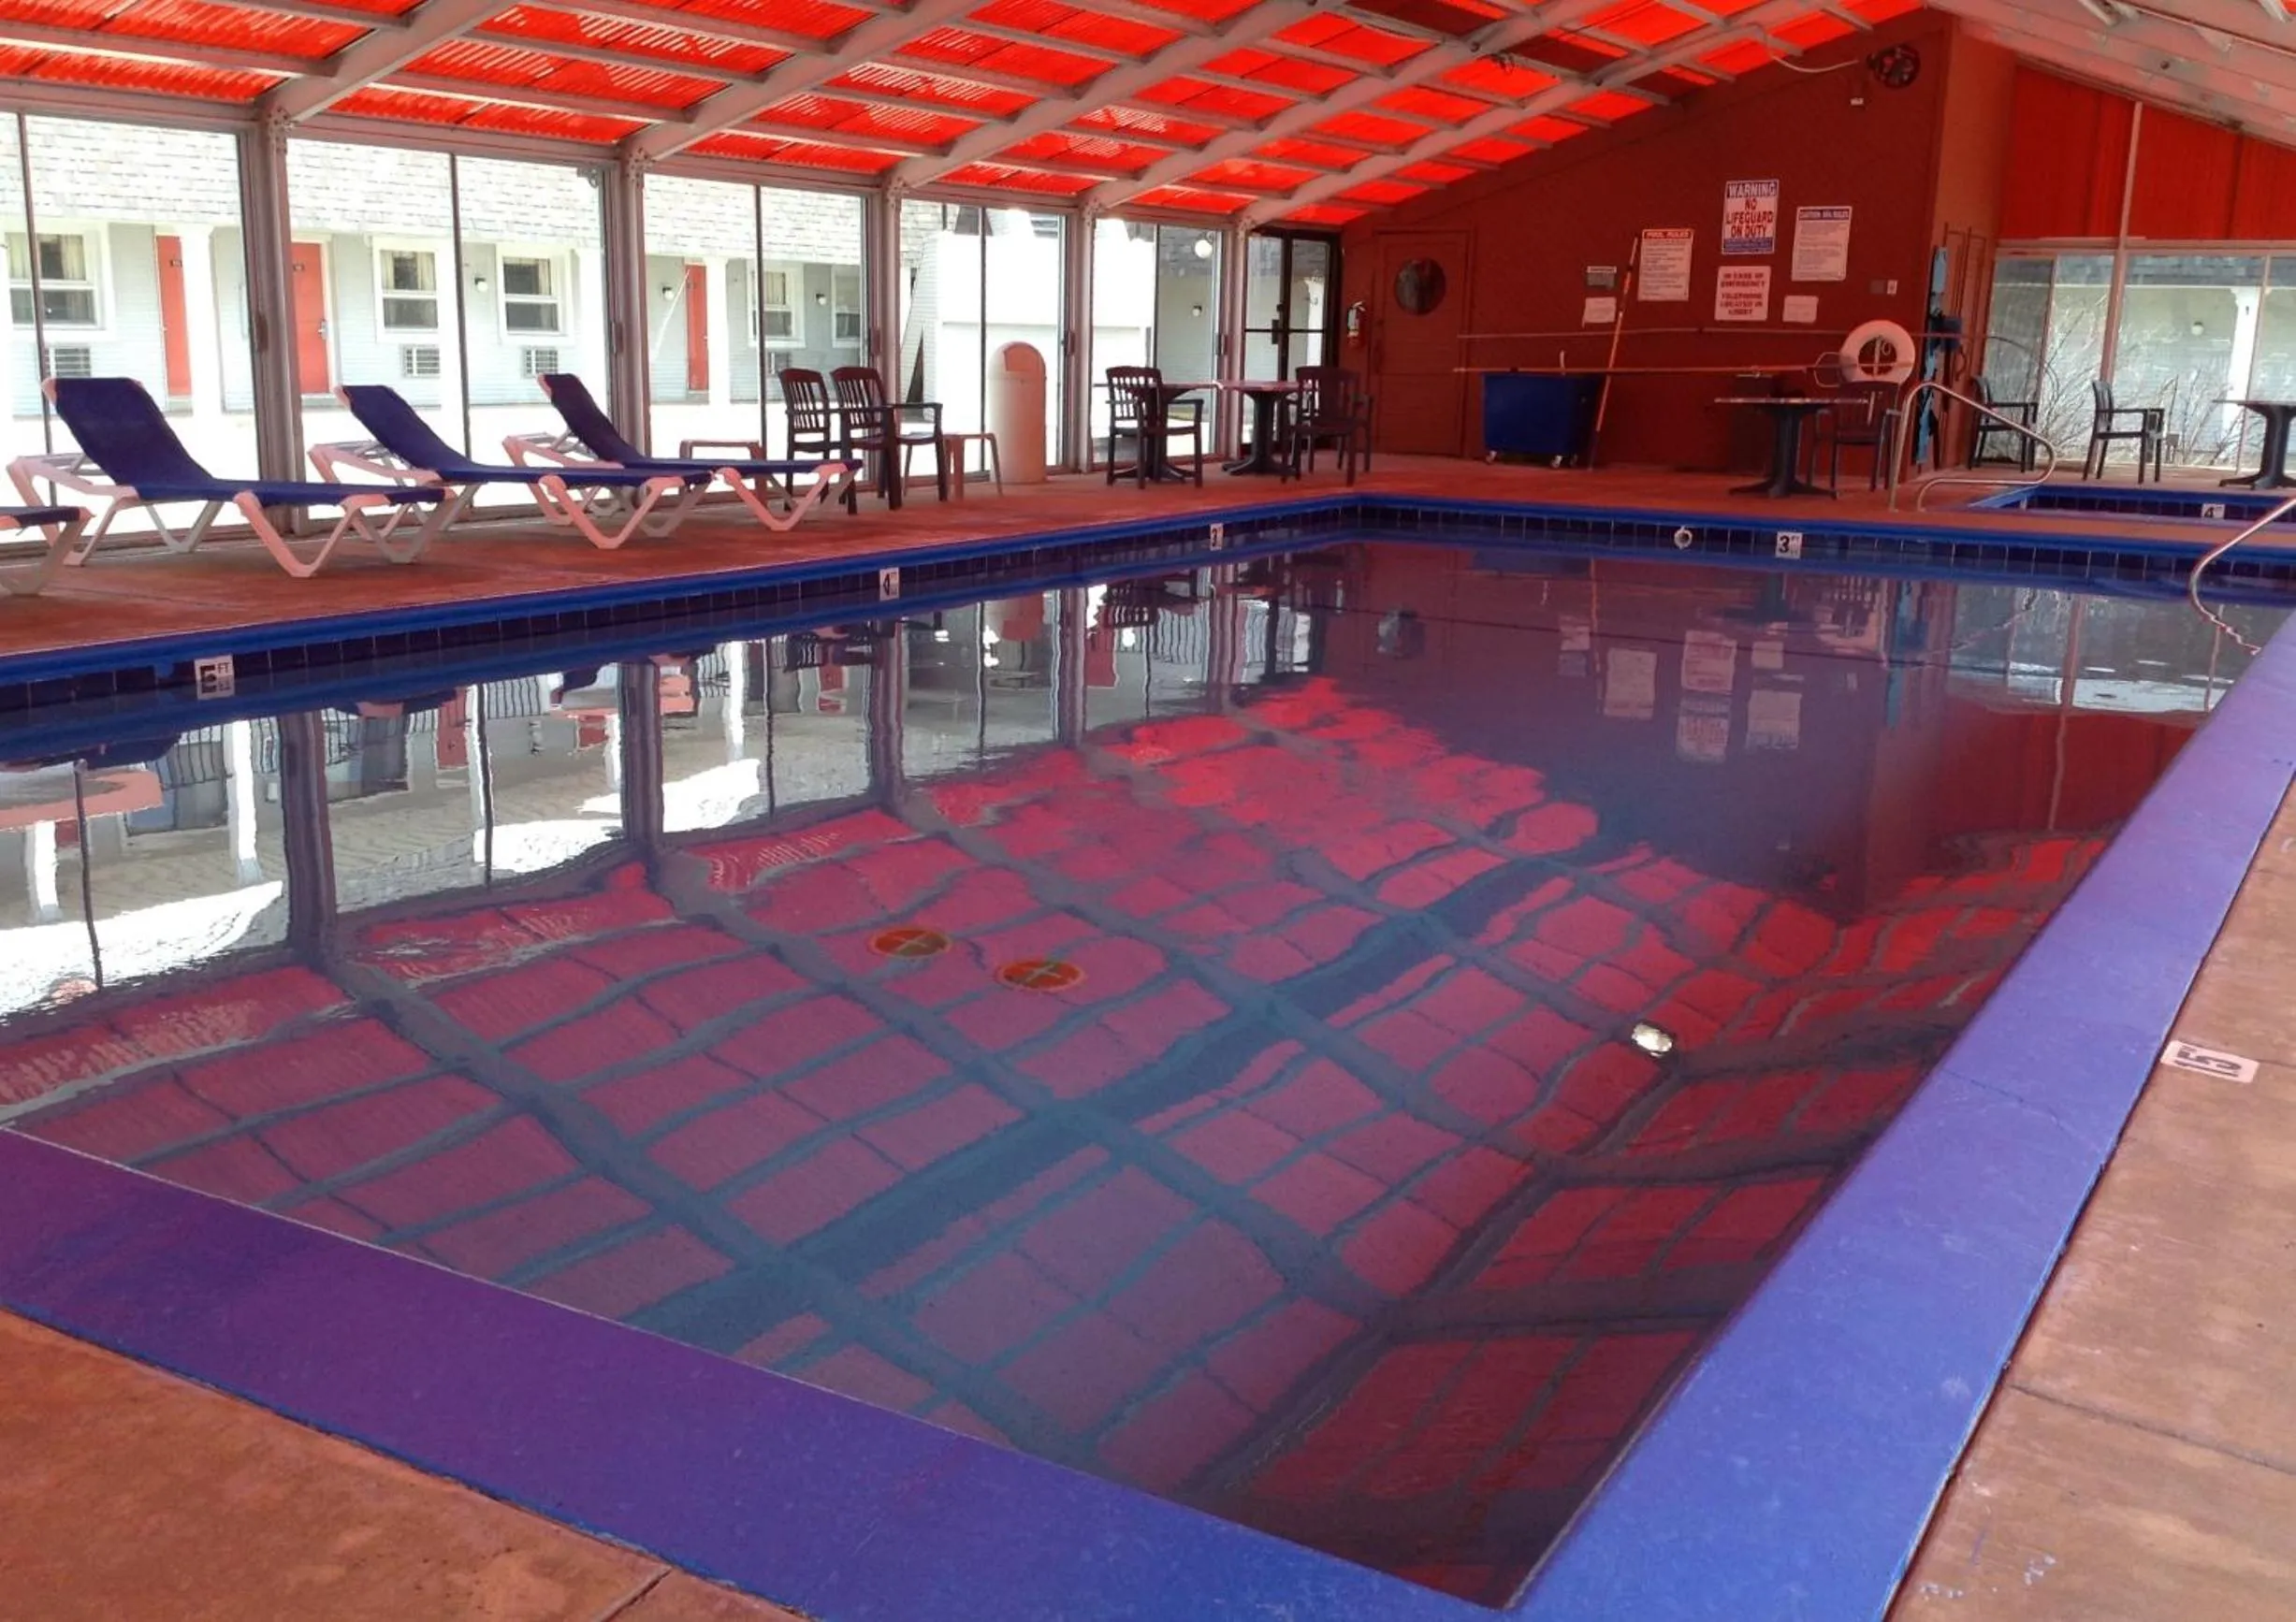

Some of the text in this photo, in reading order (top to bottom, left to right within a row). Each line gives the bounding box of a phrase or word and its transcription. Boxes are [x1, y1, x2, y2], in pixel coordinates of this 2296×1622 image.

[1727, 182, 1776, 197] WARNING
[1745, 197, 1757, 210] NO
[1725, 211, 1774, 224] LIFEGUARD
[1731, 224, 1766, 238] ON DUTY
[1780, 535, 1790, 554] 3
